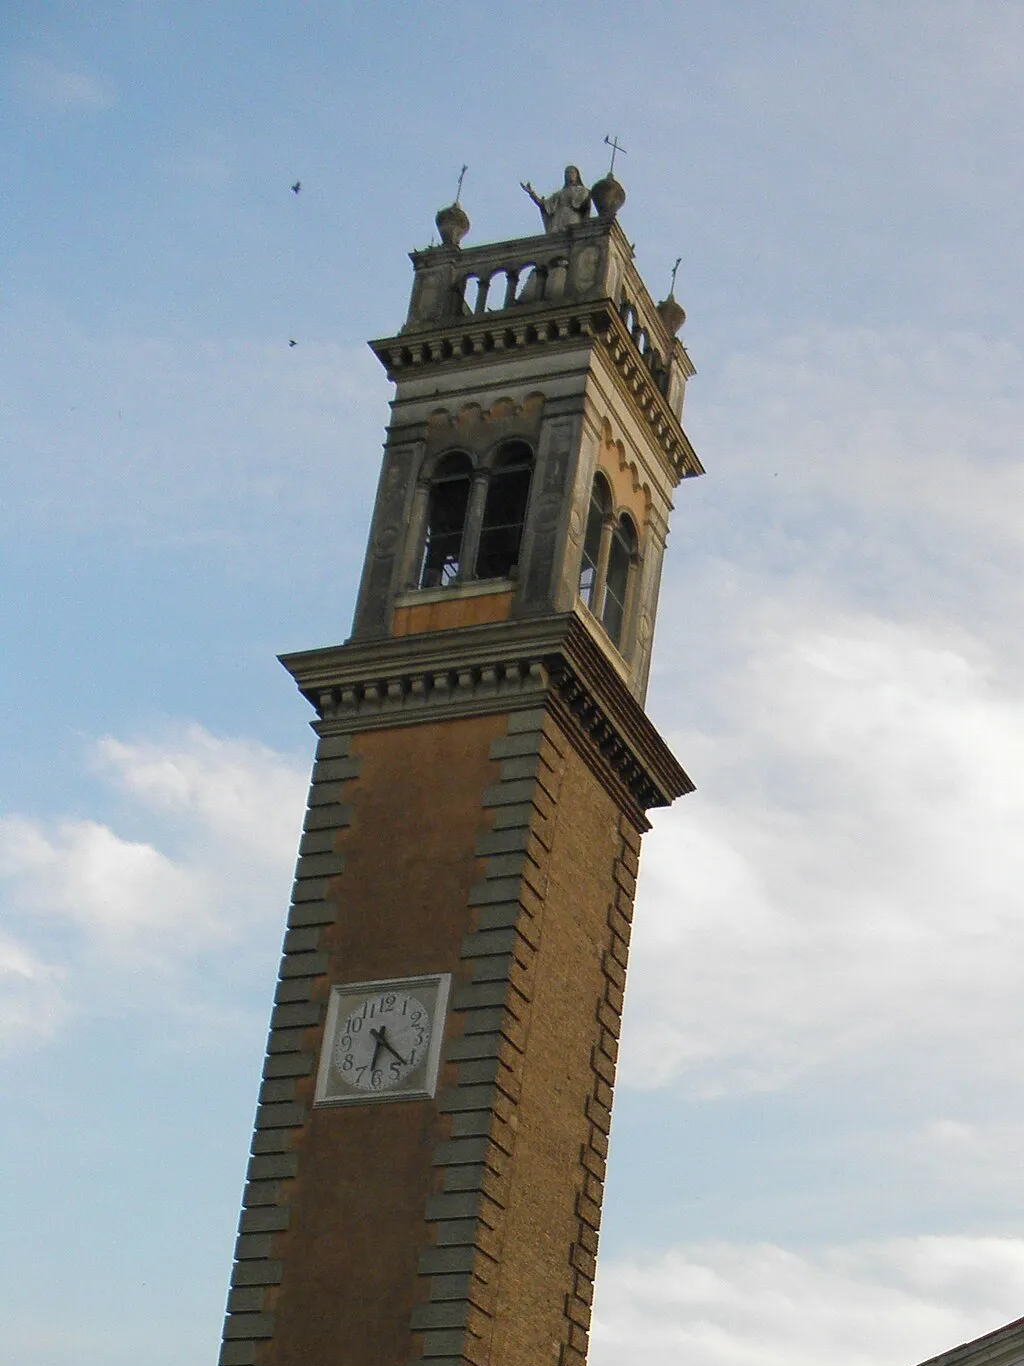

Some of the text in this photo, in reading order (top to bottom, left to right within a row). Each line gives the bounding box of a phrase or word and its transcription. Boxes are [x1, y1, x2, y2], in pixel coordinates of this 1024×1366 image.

[362, 1000, 376, 1019] 11
[380, 994, 397, 1013] 12
[401, 1000, 408, 1016] 1
[345, 1016, 362, 1034] 10
[410, 1011, 422, 1028] 2
[341, 1035, 352, 1052] 9
[414, 1027, 425, 1046] 3
[342, 1053, 354, 1071] 8
[389, 1061, 401, 1080] 5
[356, 1065, 367, 1083] 7
[371, 1068, 383, 1086] 6
